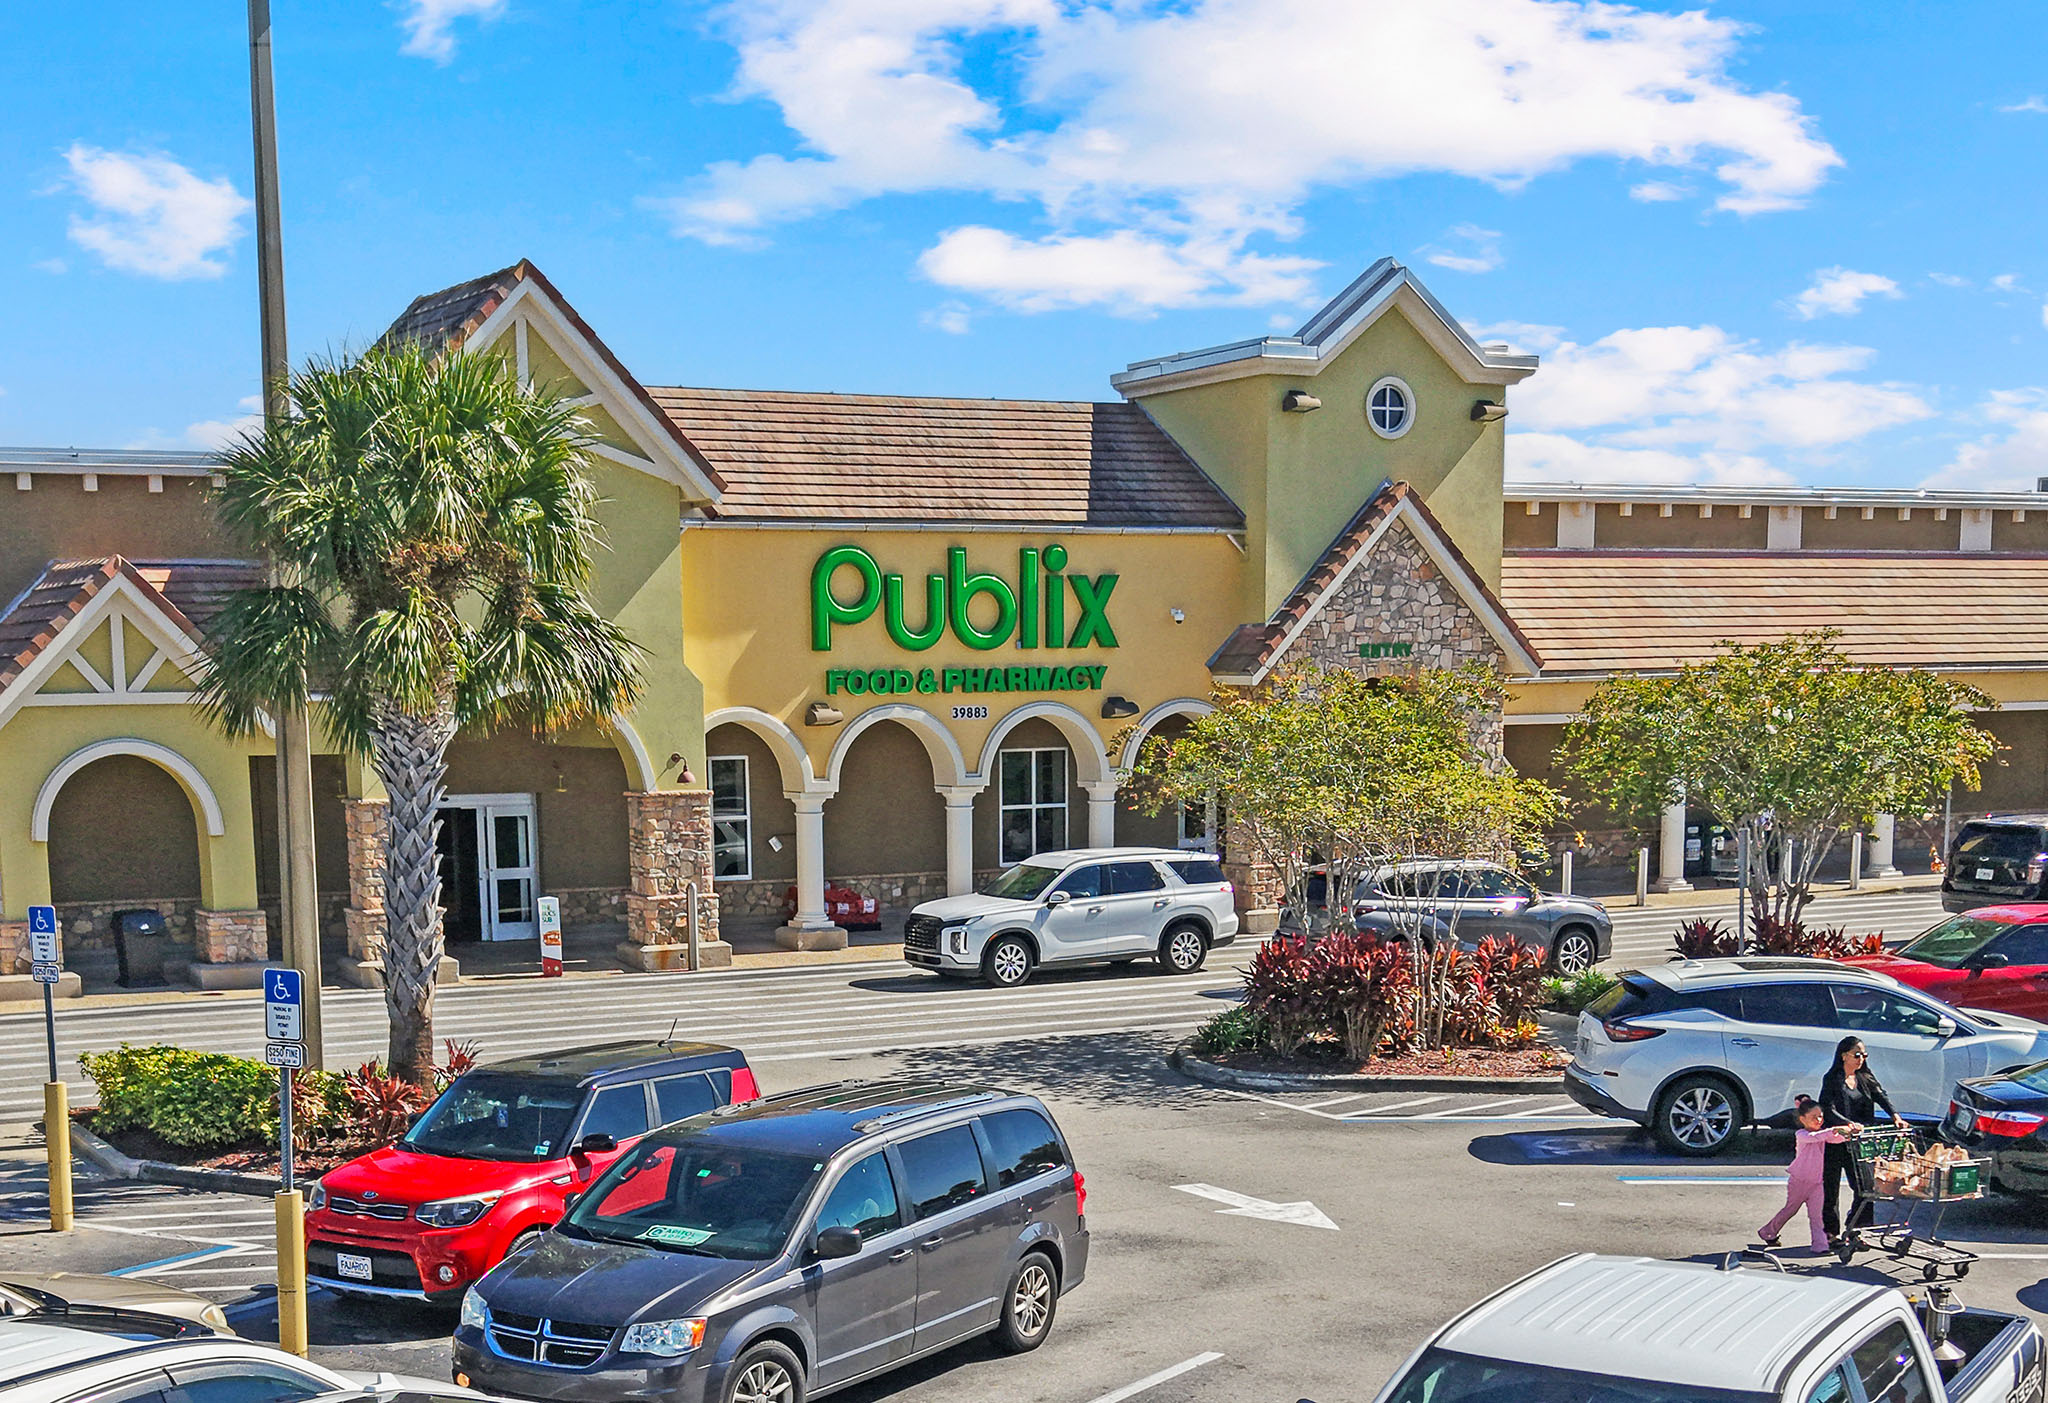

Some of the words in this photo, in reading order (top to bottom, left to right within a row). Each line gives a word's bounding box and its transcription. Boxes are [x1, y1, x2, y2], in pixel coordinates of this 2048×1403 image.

[811, 544, 1120, 651] Publix
[1360, 642, 1412, 659] ENTRY
[826, 668, 914, 695] FOOD
[918, 667, 939, 694] &
[941, 665, 1108, 693] PHARMACY
[952, 706, 988, 719] 39883
[268, 1046, 284, 1058] $250
[285, 1048, 299, 1059] FINE
